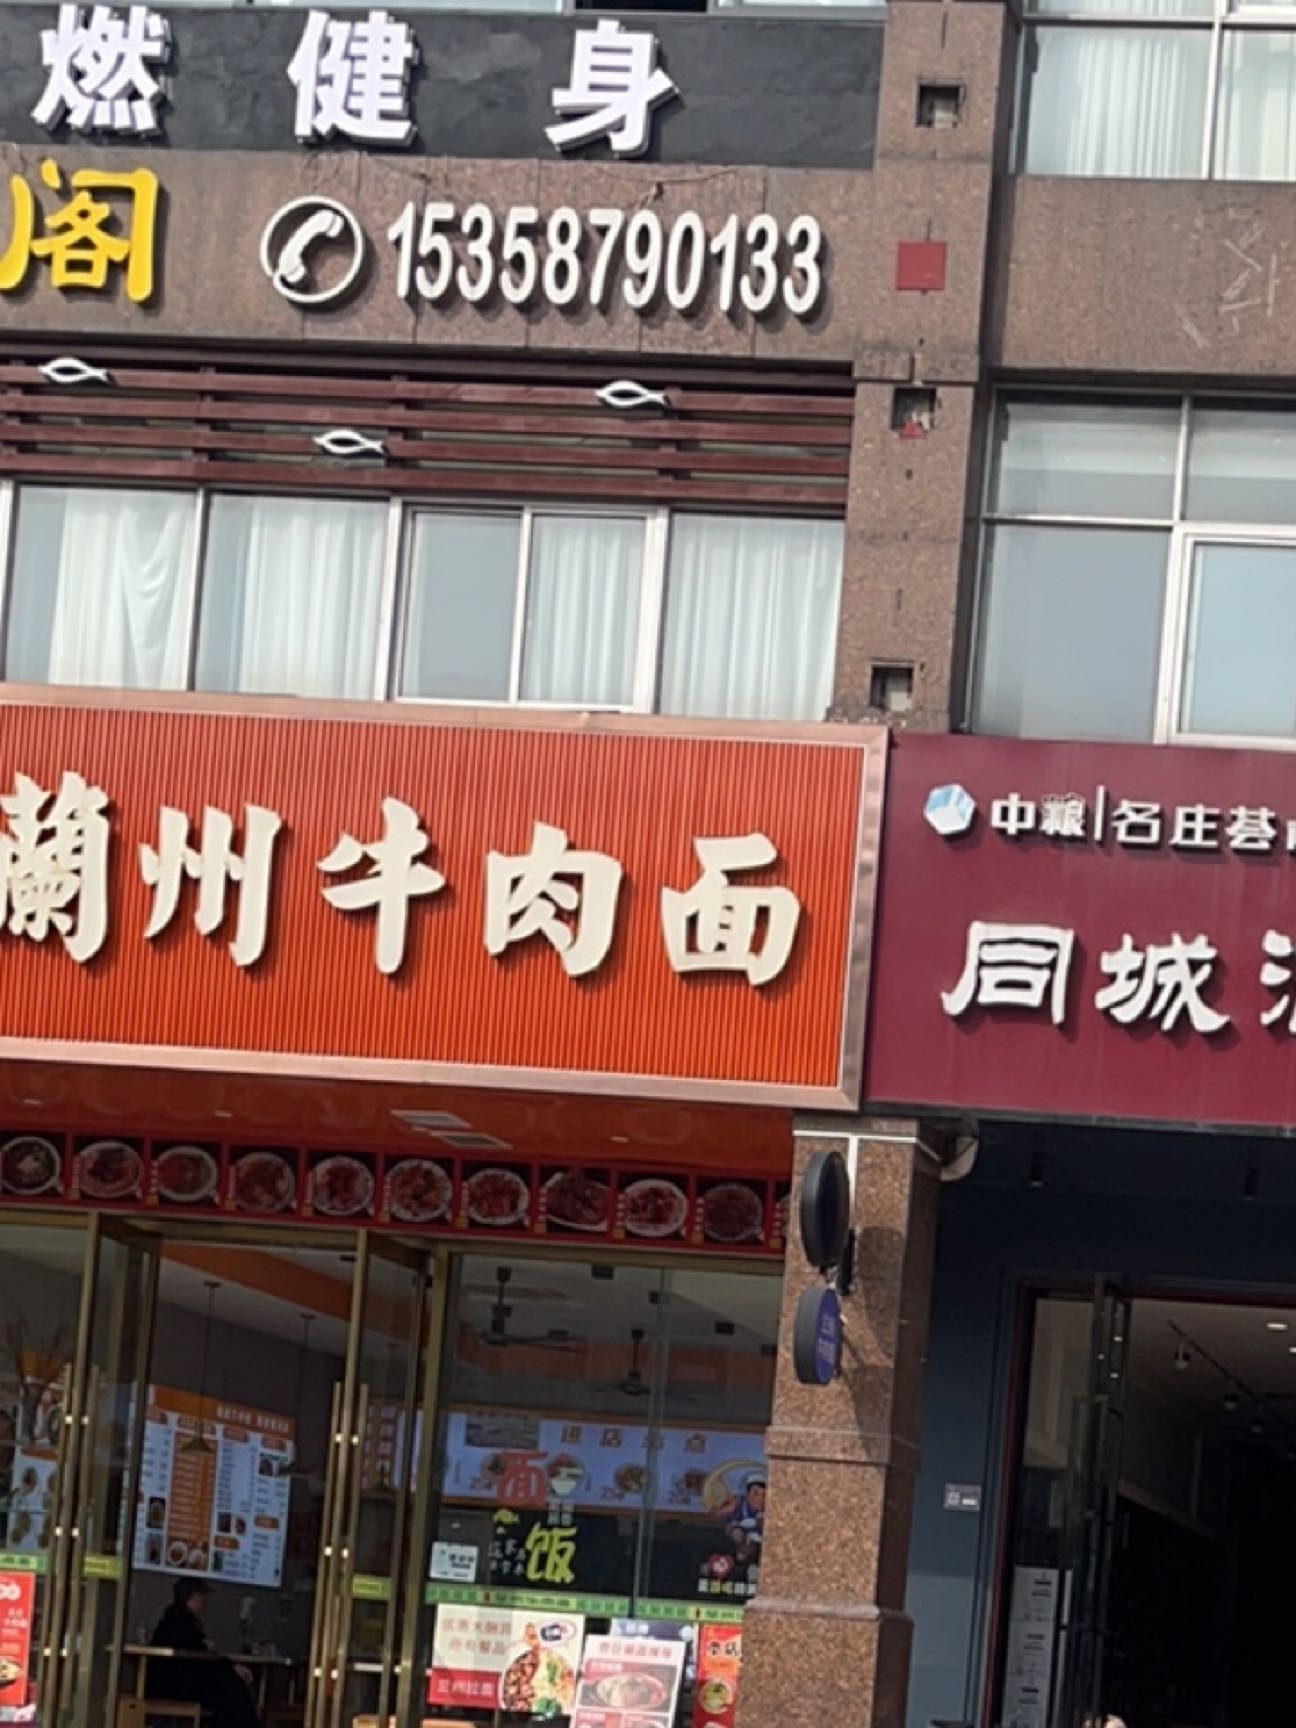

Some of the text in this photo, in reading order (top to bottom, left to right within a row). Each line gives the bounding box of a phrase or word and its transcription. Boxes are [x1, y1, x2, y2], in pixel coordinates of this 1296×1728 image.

[32, 4, 682, 153] 燃健身
[0, 159, 158, 304] 阁
[388, 202, 823, 314] 15358790133
[990, 792, 1087, 837] 中粮
[1111, 800, 1277, 851] 名庄荟
[525, 1521, 579, 1585] 饭
